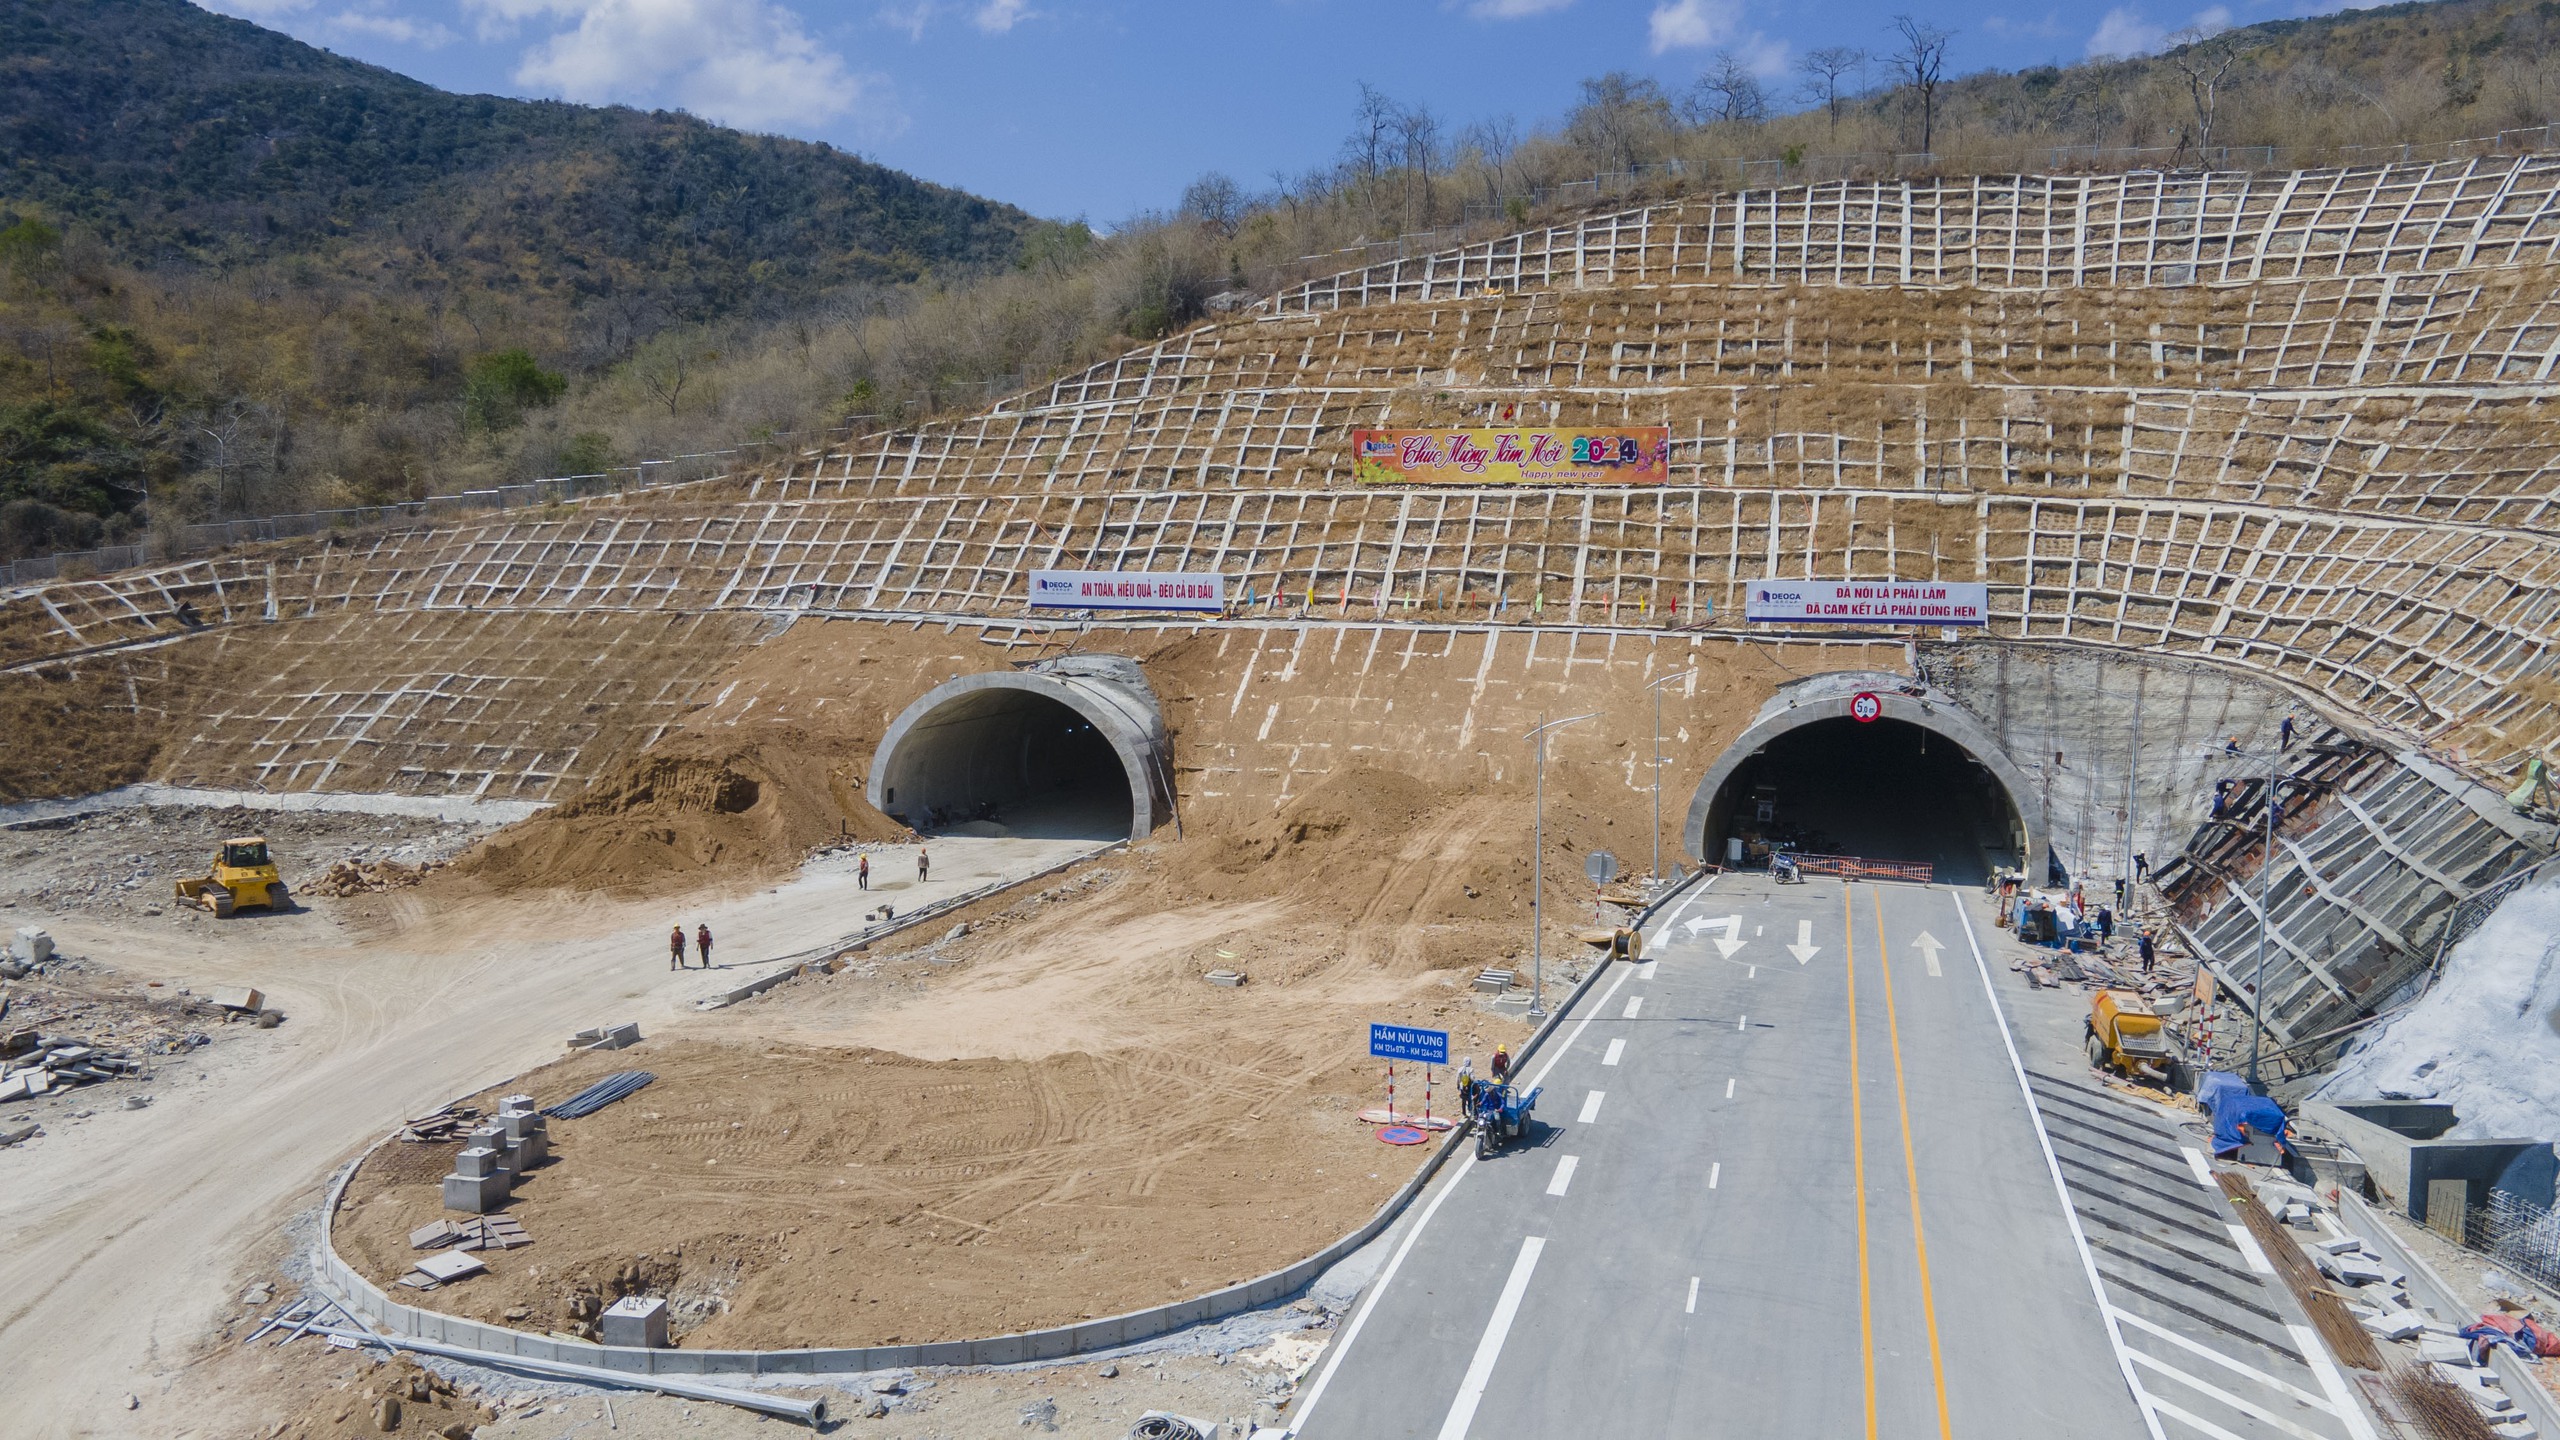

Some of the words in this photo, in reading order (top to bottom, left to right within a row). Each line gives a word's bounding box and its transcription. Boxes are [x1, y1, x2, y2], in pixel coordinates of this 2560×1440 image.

[1401, 435, 1443, 470] Chúc
[1435, 434, 1489, 474] Mừng
[1488, 433, 1525, 464] Năm
[1518, 433, 1568, 469] Mới
[1571, 437, 1637, 463] 2024
[1520, 470, 1554, 479] Happy
[1580, 471, 1604, 479] year
[1081, 582, 1092, 597] AN
[1093, 580, 1116, 599] TOÀN,
[1117, 580, 1135, 600] HIỆU
[1136, 579, 1152, 599] QUẢ
[1188, 584, 1196, 598] ĐI
[1836, 585, 1851, 598] ĐÃ
[1854, 585, 1873, 599] NÓI
[1876, 586, 1890, 599] LÀ
[1893, 585, 1919, 599] PHẢI
[1922, 586, 1946, 600] LÀM
[1806, 602, 1820, 614] ĐÃ
[1824, 604, 1848, 615] CAM
[1851, 601, 1871, 615] KẾT
[1874, 602, 1888, 615] LÀ
[1891, 602, 1917, 615] PHẢI
[1920, 603, 1951, 617] ĐÚNG
[1954, 606, 1977, 619] HẸN
[1398, 1030, 1415, 1044] NÚI
[1416, 1034, 1443, 1047] VUNG
[1374, 1042, 1384, 1051] KM
[1410, 1047, 1420, 1056] KM
